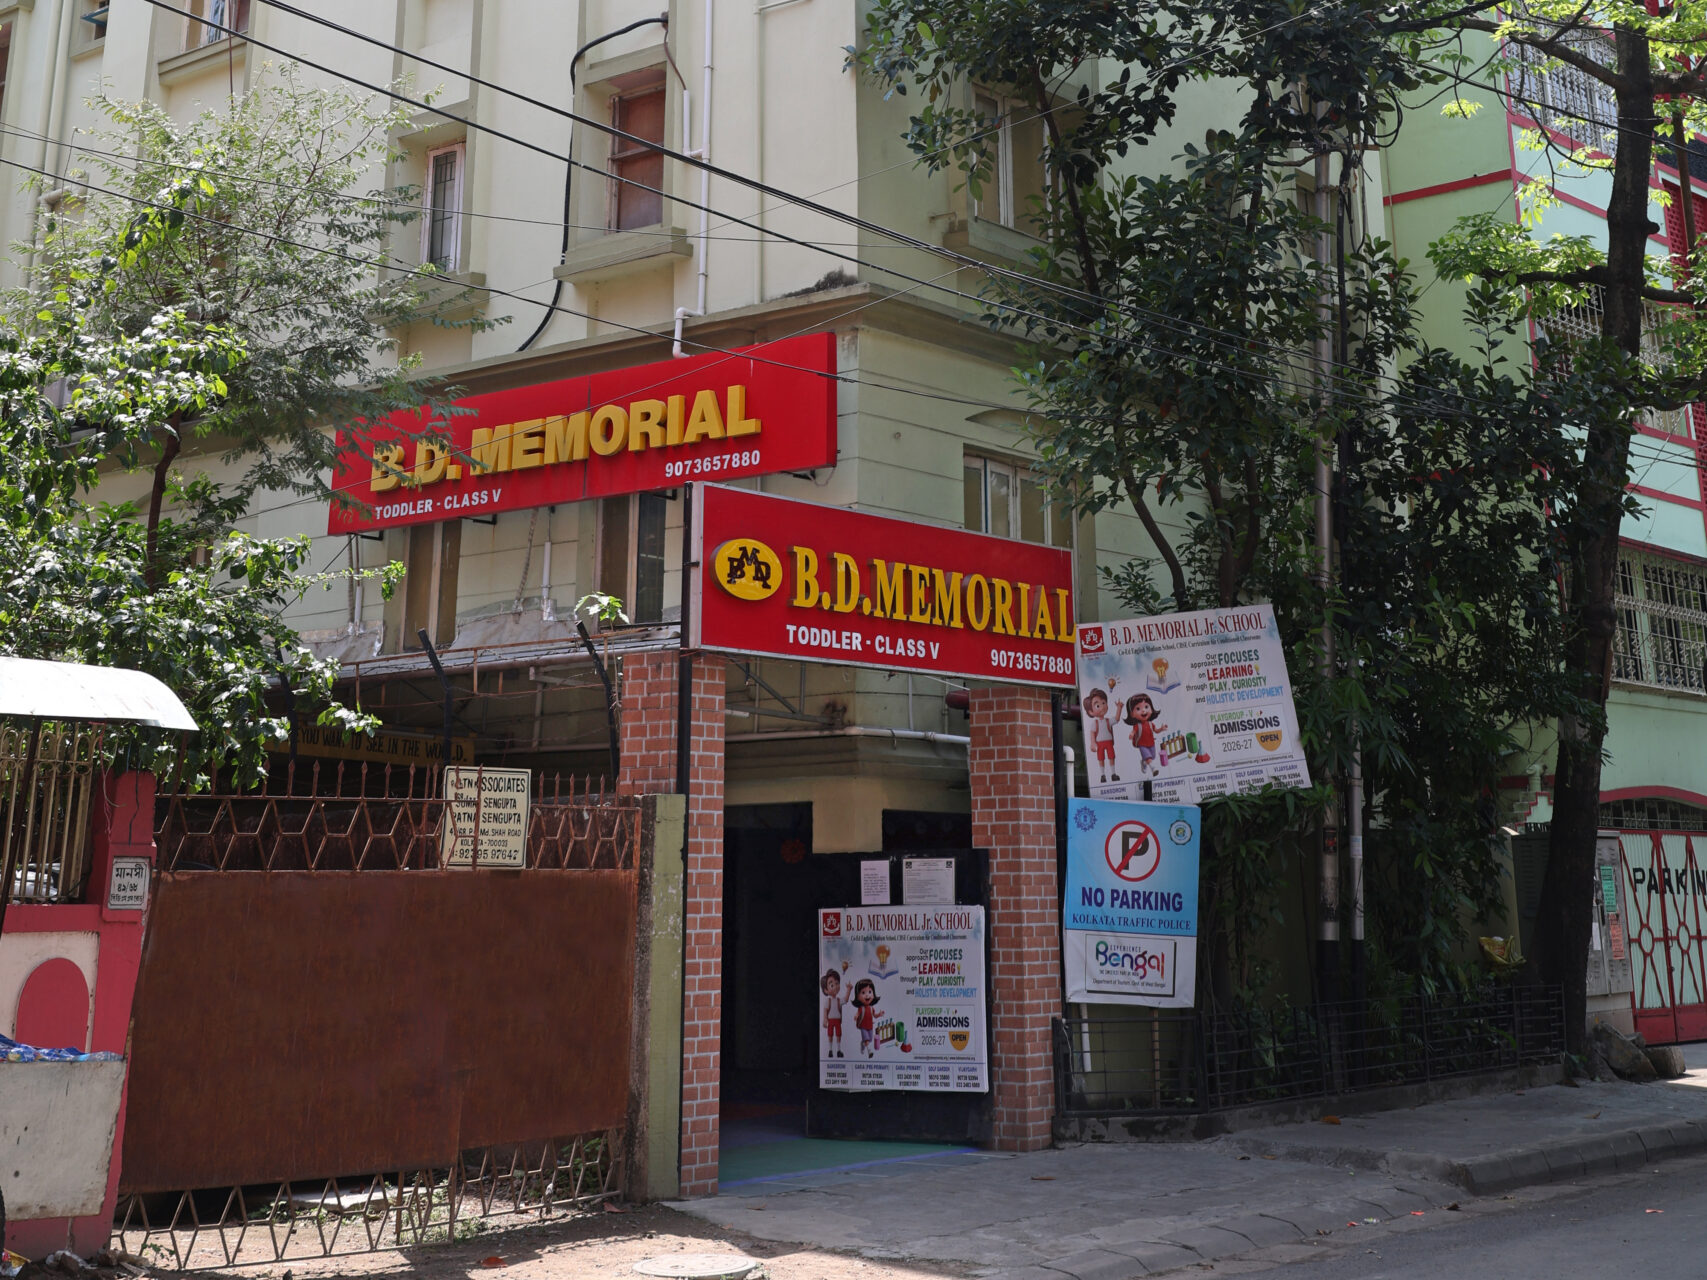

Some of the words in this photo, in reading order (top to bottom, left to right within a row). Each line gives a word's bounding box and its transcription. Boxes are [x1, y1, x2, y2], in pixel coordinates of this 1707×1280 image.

[470, 384, 761, 478] MEMORIAL
[665, 450, 760, 479] 9073657880
[375, 498, 433, 520] TODDLER
[444, 492, 488, 510] CLASS
[490, 488, 502, 504] V
[1110, 627, 1121, 646] B.
[1122, 626, 1135, 645] D.
[1137, 618, 1203, 643] MEMORIAL
[1204, 617, 1217, 636] Jr.
[1217, 612, 1267, 634] SCHOOL
[786, 623, 863, 652] TODDLER
[874, 634, 926, 658] CLASS
[930, 641, 940, 660] V
[991, 648, 1072, 675] 9073657880
[1190, 659, 1218, 669] approach
[1206, 653, 1217, 661] Our
[1218, 649, 1260, 666] FOCUSES
[1207, 663, 1254, 681] LEARNING
[1186, 682, 1208, 692] through
[1232, 676, 1267, 690] CURIOSITY
[1196, 696, 1206, 704] and
[1206, 691, 1235, 705] HOLISTIC
[1237, 685, 1284, 702] DEVELOPMENT
[1210, 710, 1245, 723] PLAYGROUP
[1213, 716, 1281, 735] ADMISSIONS
[301, 727, 320, 745] YOU
[322, 728, 346, 748] WAN
[366, 734, 384, 753] SEE
[387, 736, 398, 755] IN
[402, 739, 420, 757] THE
[424, 741, 468, 763] WORD.
[1222, 738, 1253, 753] 2026-27
[1260, 734, 1280, 744] OPEN
[484, 797, 517, 810] SENGUPTA
[482, 812, 521, 824] SENGUPTA
[508, 828, 522, 838] ROAD
[490, 848, 520, 861] 97647
[115, 864, 144, 879] মানসী
[1632, 867, 1707, 896] PARKIN
[1081, 887, 1105, 908] NO
[1110, 888, 1183, 912] PARKING
[846, 914, 854, 932] B.
[856, 914, 865, 932] D.
[868, 913, 920, 932] MEMORIAL
[922, 913, 932, 930] Jr.
[934, 912, 973, 930] SCHOOL
[1072, 914, 1116, 926] KOLKATA
[1118, 916, 1157, 929] TRAFFIC
[1158, 919, 1191, 930] POLICE
[929, 948, 963, 961] FOCUSES
[1096, 940, 1165, 980] Bengal
[918, 963, 956, 975] LEARNING
[900, 976, 918, 984] through
[936, 976, 966, 986] CURIOSITY
[914, 988, 937, 998] HOLISTIC
[939, 988, 977, 998] DEVELOPMENT
[916, 1016, 970, 1028] ADMISSIONS
[922, 1035, 946, 1046] 2026-27
[952, 1034, 967, 1042] OPEN
